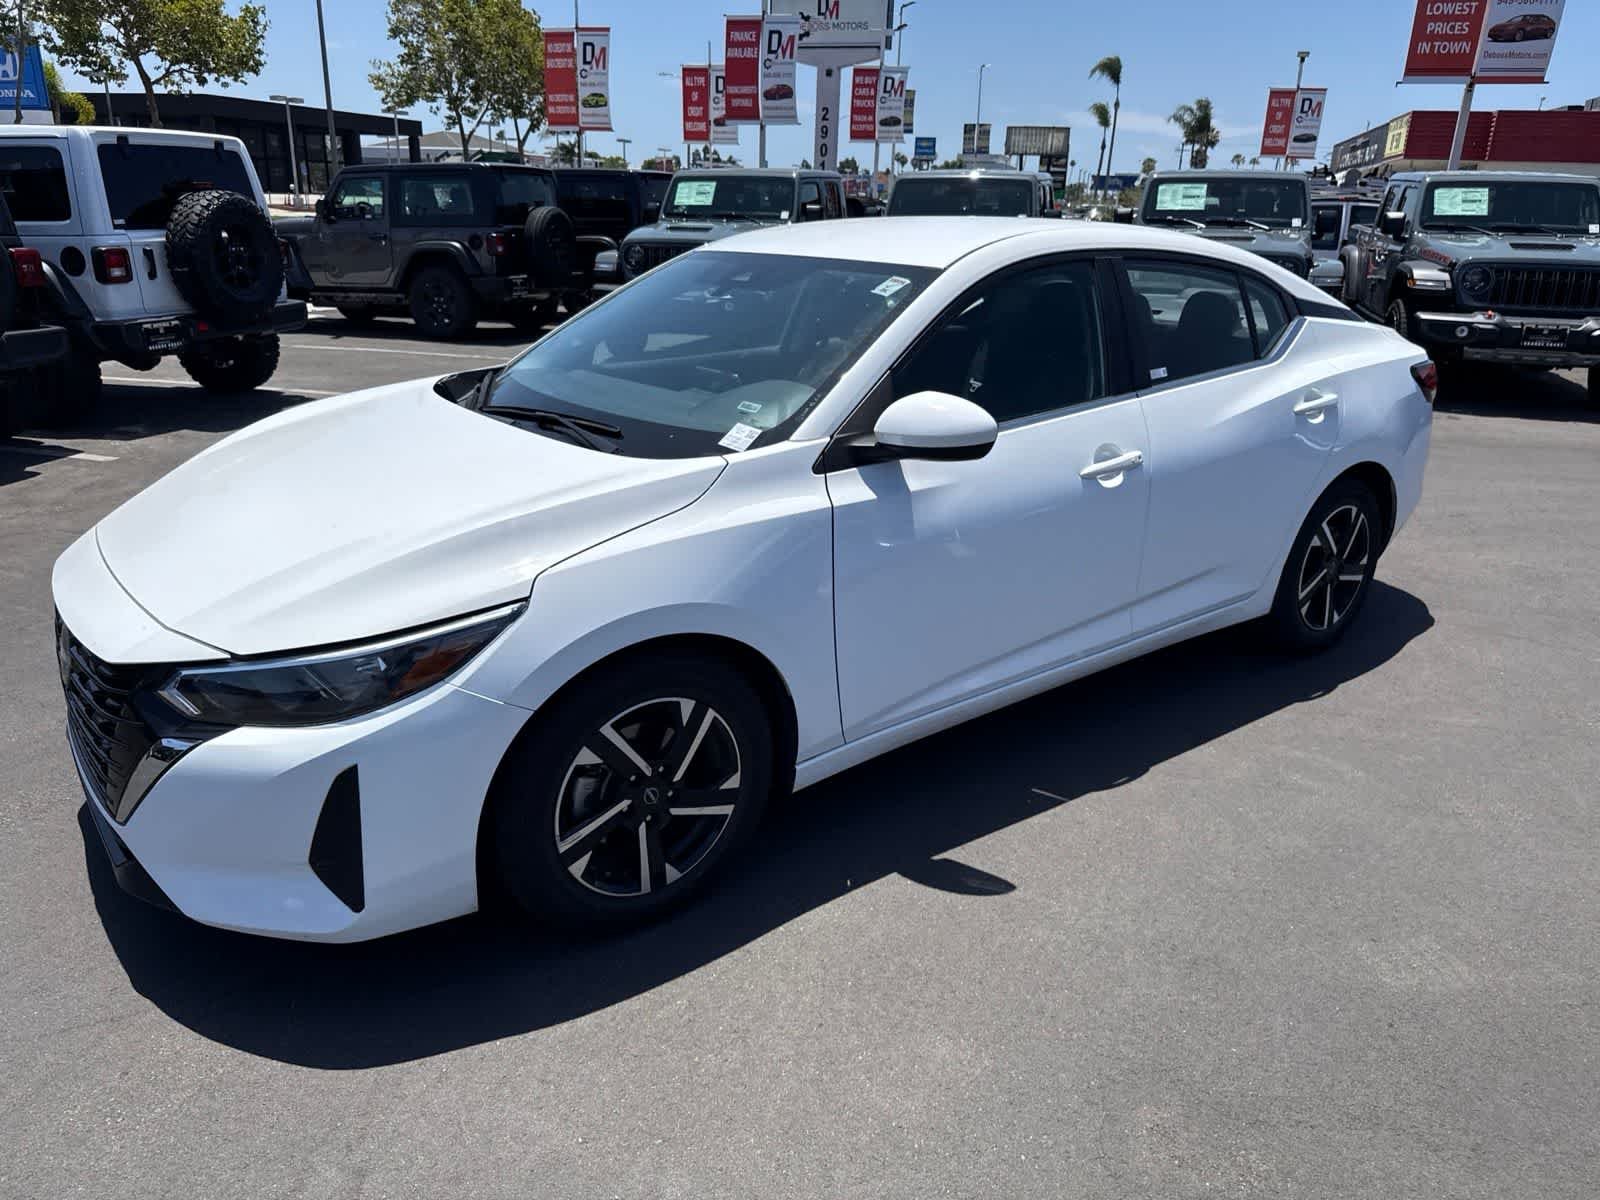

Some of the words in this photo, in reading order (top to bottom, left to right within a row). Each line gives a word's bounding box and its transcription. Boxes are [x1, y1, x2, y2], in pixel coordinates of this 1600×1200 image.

[1426, 2, 1478, 15] LOWEST
[832, 21, 869, 31] MOTORS
[1426, 22, 1470, 34] PRICES
[730, 31, 757, 41] FINANCE
[767, 29, 796, 60] DM
[1417, 42, 1431, 54] IN
[1432, 41, 1472, 54] TOWN
[727, 47, 758, 58] AVAILABLE
[883, 76, 905, 98] DM
